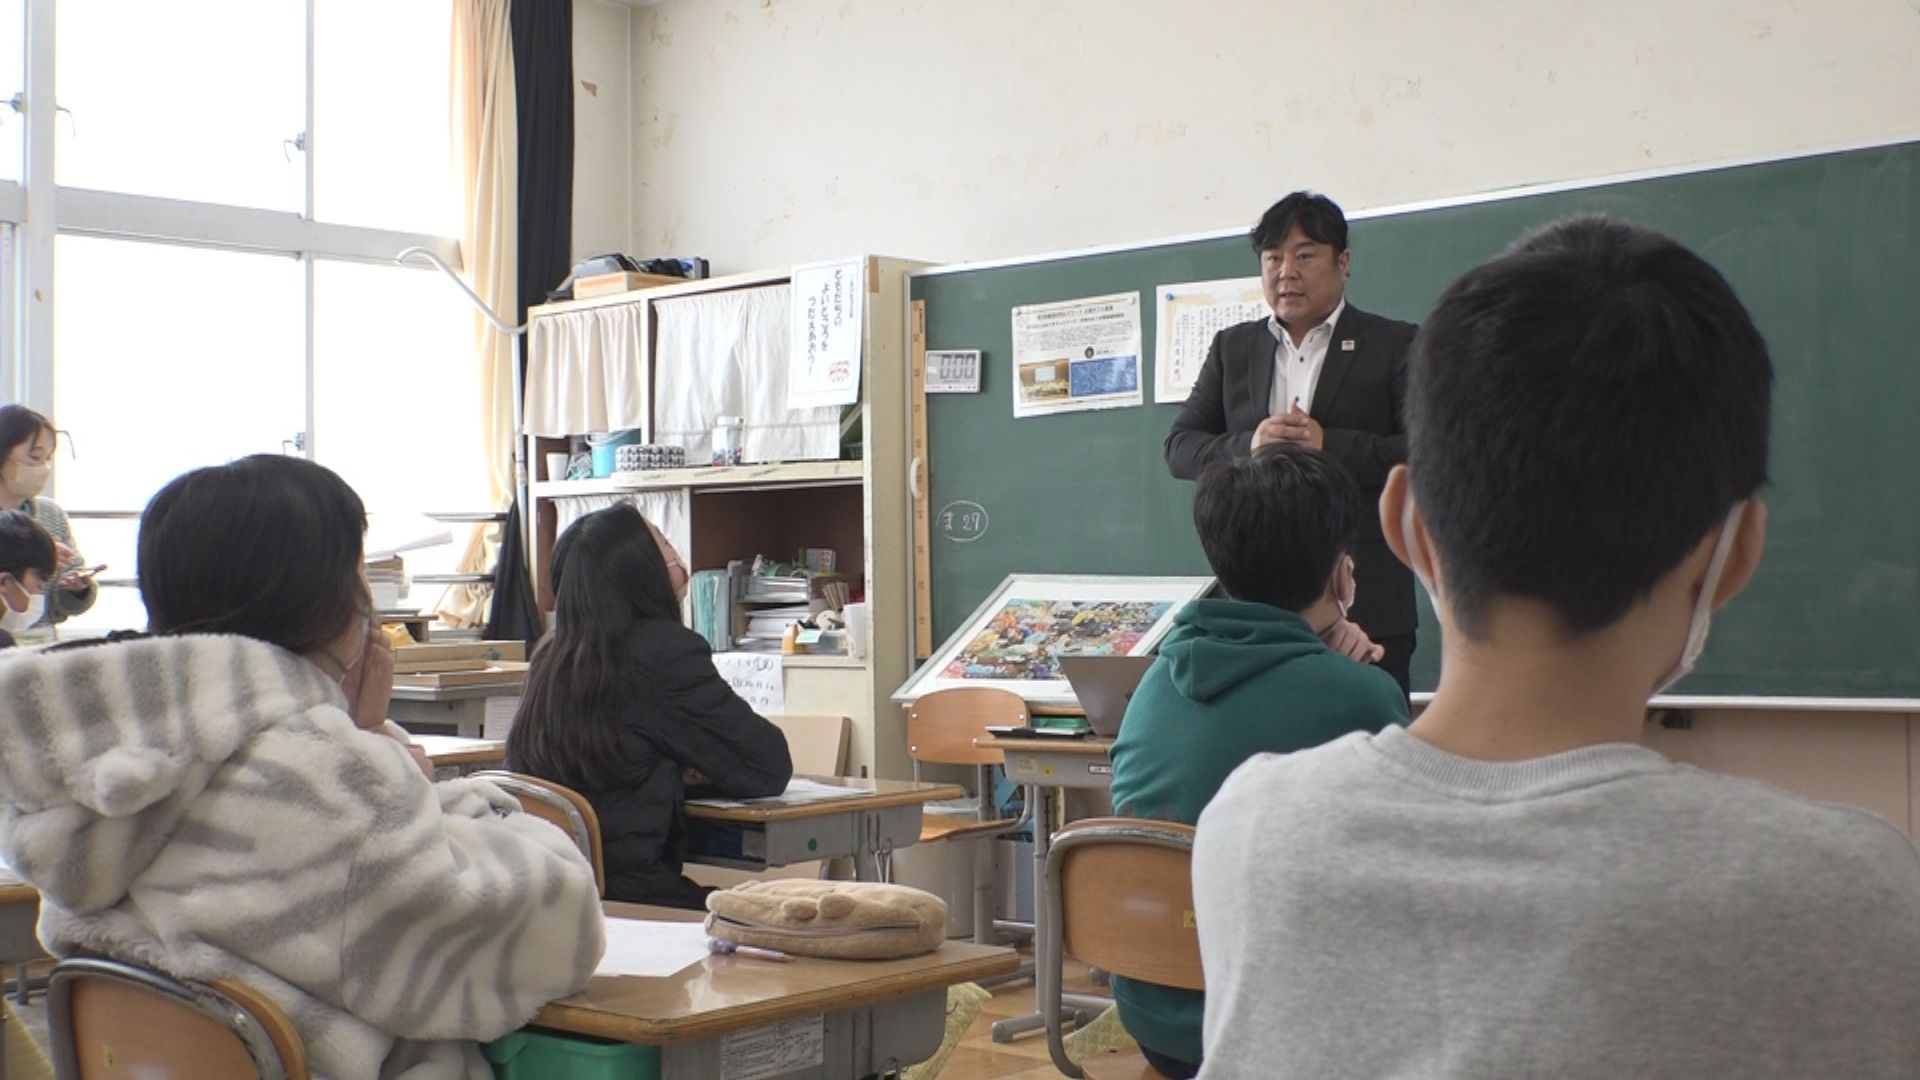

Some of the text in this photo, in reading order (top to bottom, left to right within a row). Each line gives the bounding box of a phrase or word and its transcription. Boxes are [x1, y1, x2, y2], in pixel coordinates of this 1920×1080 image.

[820, 282, 831, 352] よいところを
[834, 269, 843, 327] ともだちの
